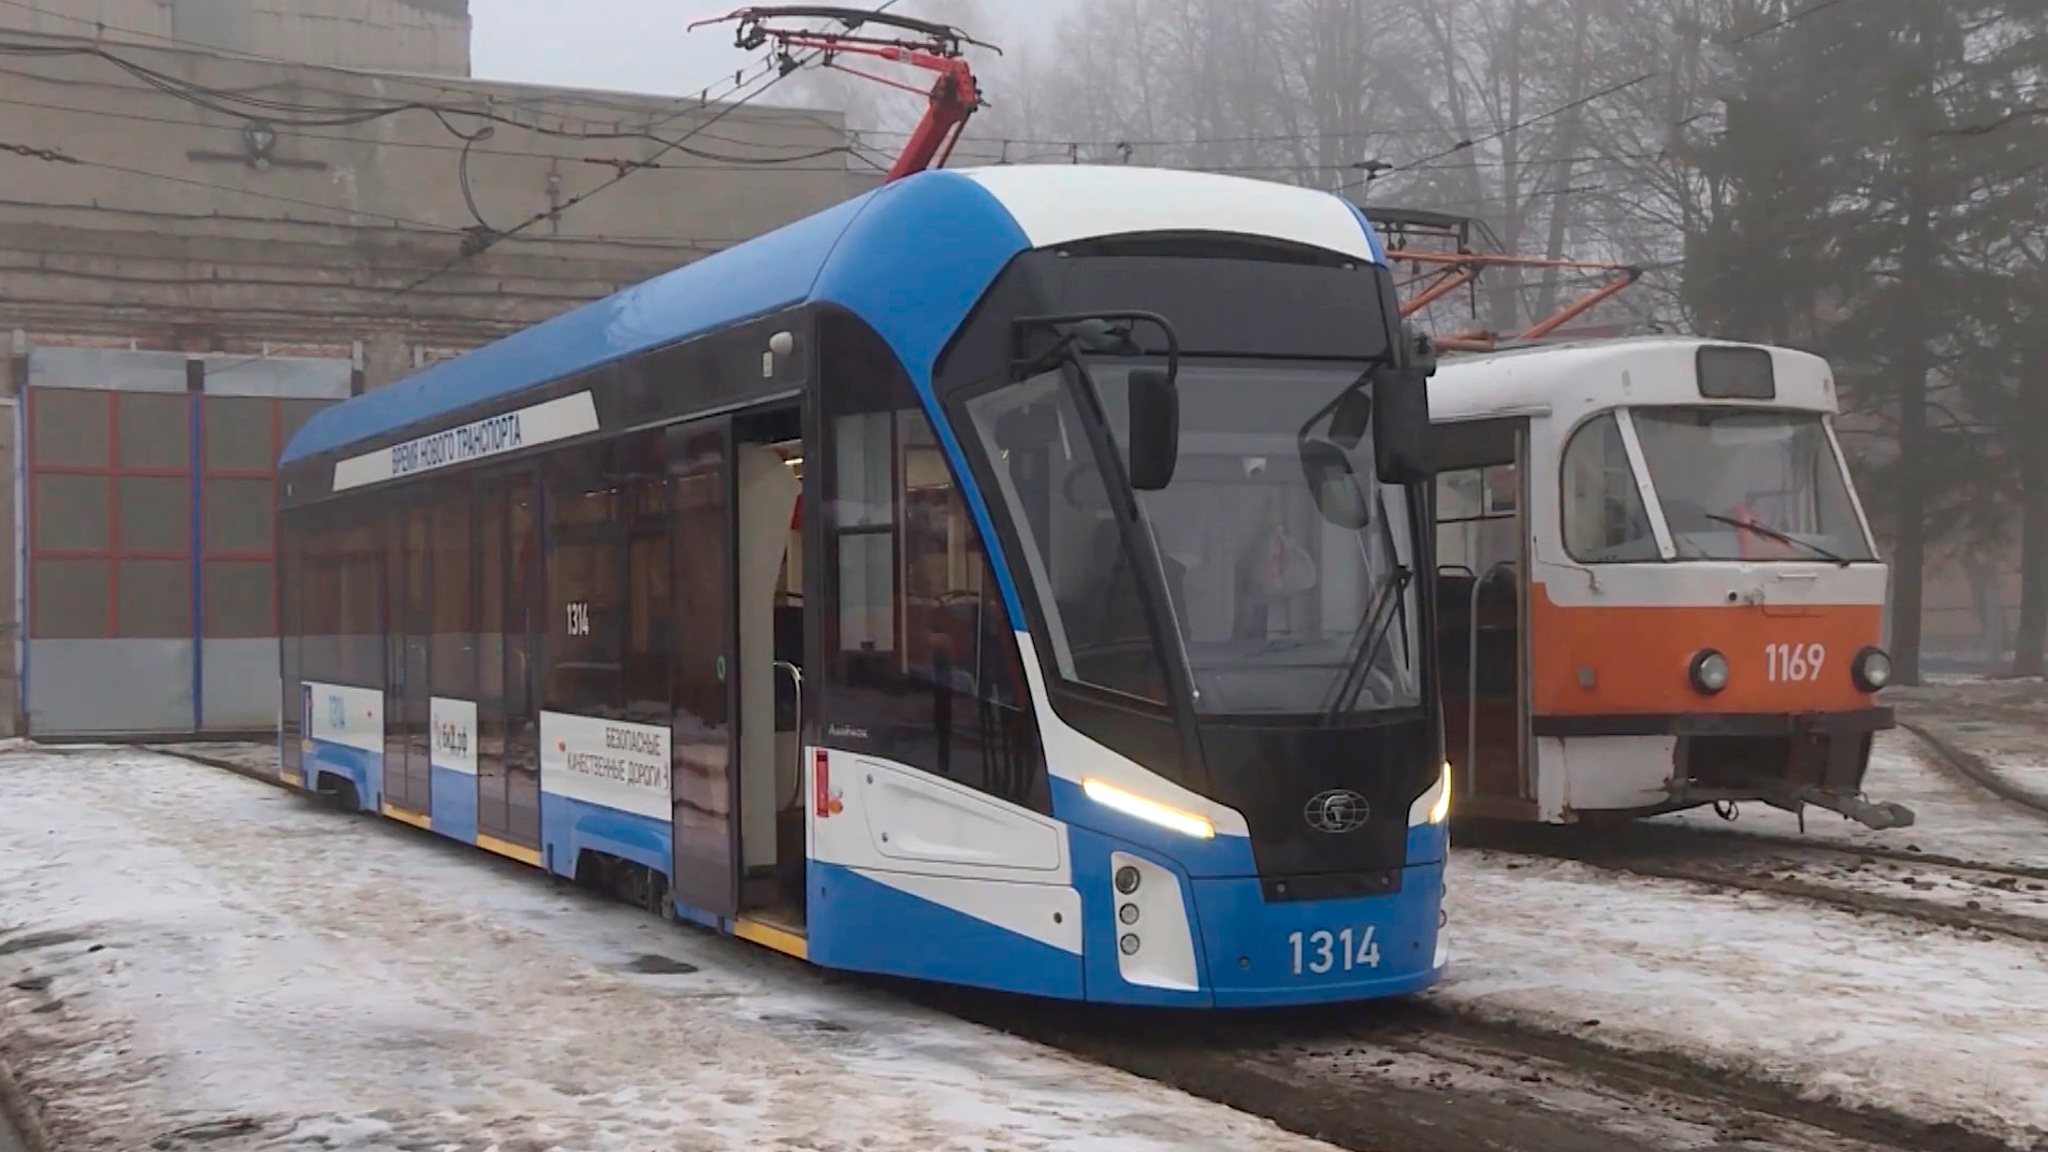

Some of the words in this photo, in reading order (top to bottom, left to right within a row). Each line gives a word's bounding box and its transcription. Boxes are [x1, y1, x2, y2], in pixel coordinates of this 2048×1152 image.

[392, 442, 419, 475] ВРЕМЯ
[420, 432, 456, 467] НОВОГО
[457, 413, 521, 457] ТРАНСПОРТА
[567, 602, 589, 635] 1314
[1765, 642, 1825, 682] 1169
[606, 726, 661, 757] БЕЗОПАСНЫЕ
[567, 752, 625, 781] КАЧЕСТВЕННЫЕ
[627, 760, 661, 788] ДОРОГИ
[1289, 925, 1380, 975] 1314
